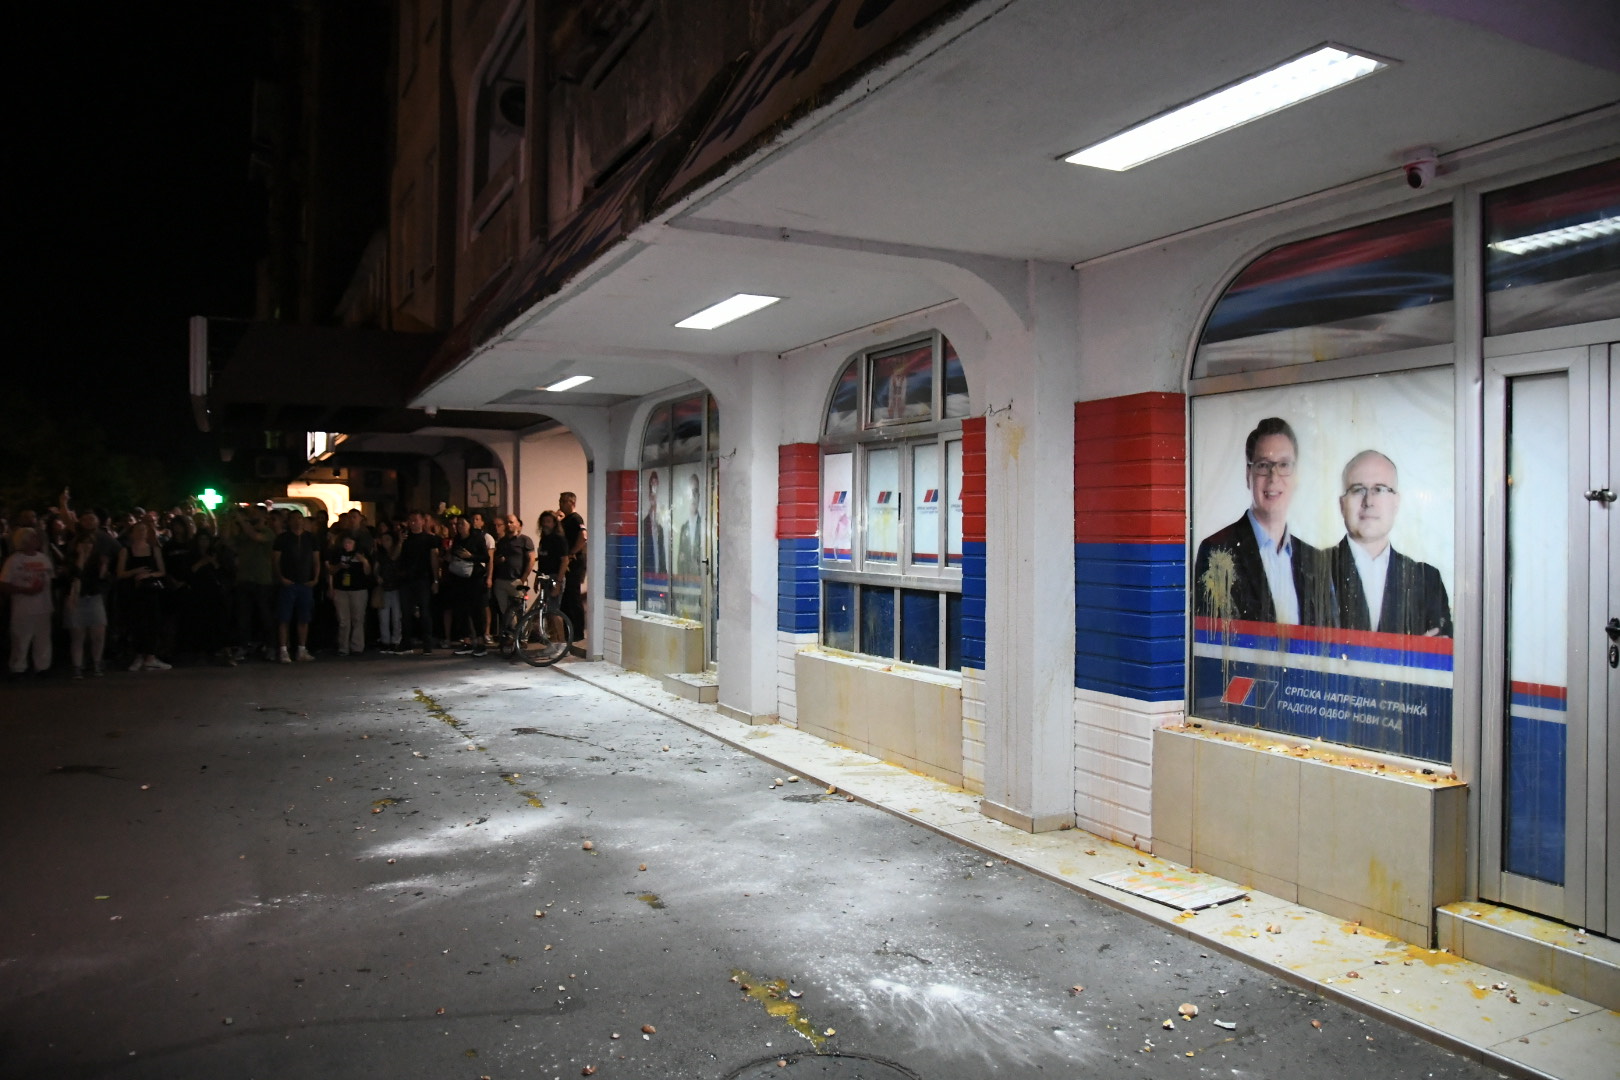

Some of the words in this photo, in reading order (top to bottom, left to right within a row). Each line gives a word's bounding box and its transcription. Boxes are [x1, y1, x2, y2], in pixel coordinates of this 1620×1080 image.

[1277, 700, 1317, 715] ГРАДСКИ
[1318, 706, 1350, 720] ОДБОР
[1352, 713, 1379, 725] НОВИ
[1382, 717, 1403, 731] САД
[1284, 686, 1321, 700] СРПСКА
[1324, 691, 1377, 708] НАПРЕДНА
[1379, 700, 1428, 716] СТРАНКА
